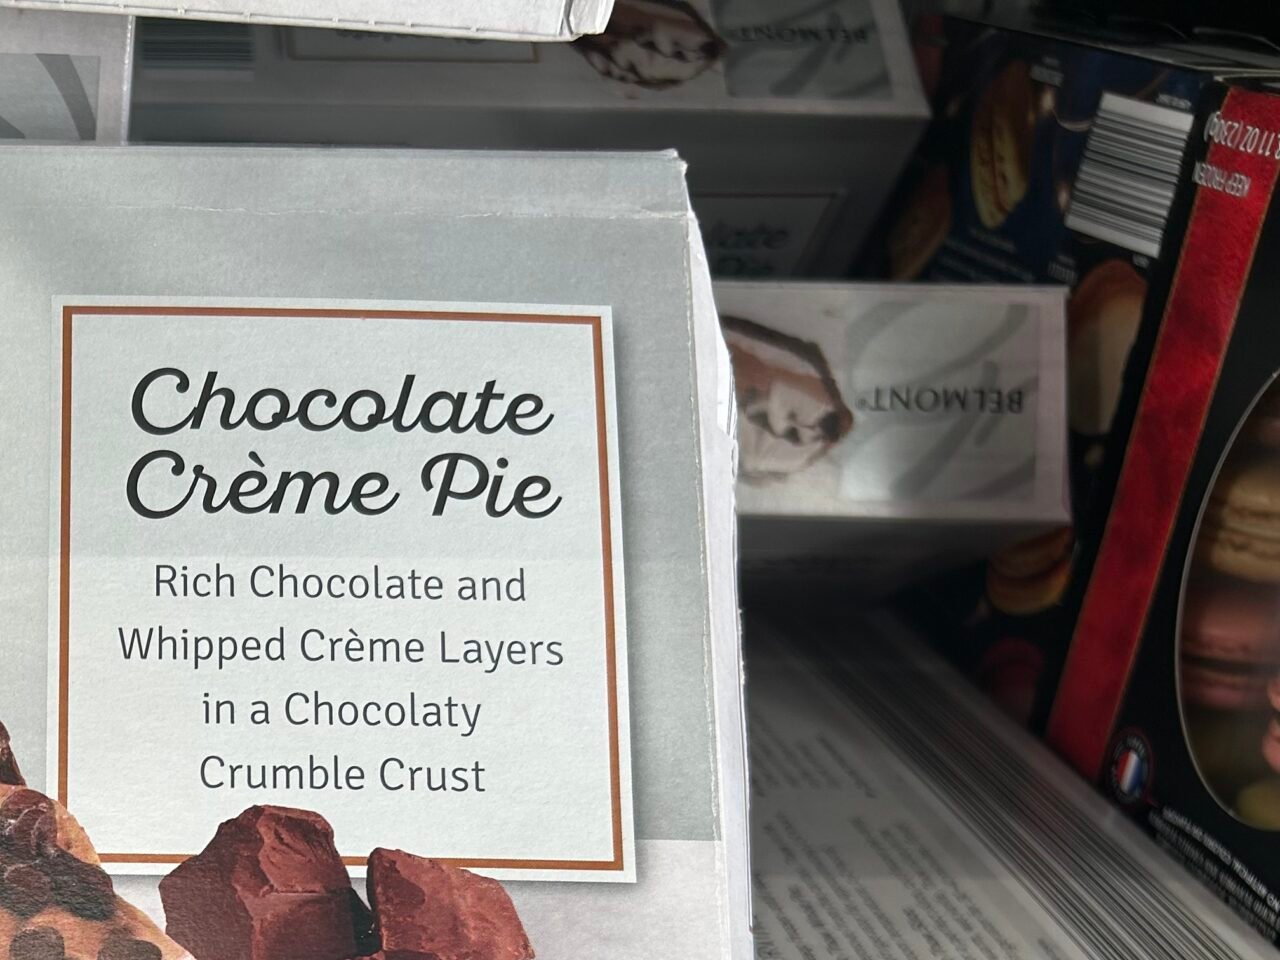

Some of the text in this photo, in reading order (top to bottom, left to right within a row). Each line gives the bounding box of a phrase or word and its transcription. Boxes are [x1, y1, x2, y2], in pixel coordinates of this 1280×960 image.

[130, 366, 554, 436] Chocolate
[126, 450, 563, 519] Crème Pie
[155, 563, 526, 602] Rich Chocolate and
[118, 626, 564, 673] Whipped Crème Layers
[203, 692, 481, 736] in a Chocolaty
[200, 755, 486, 793] Crumble Crust
